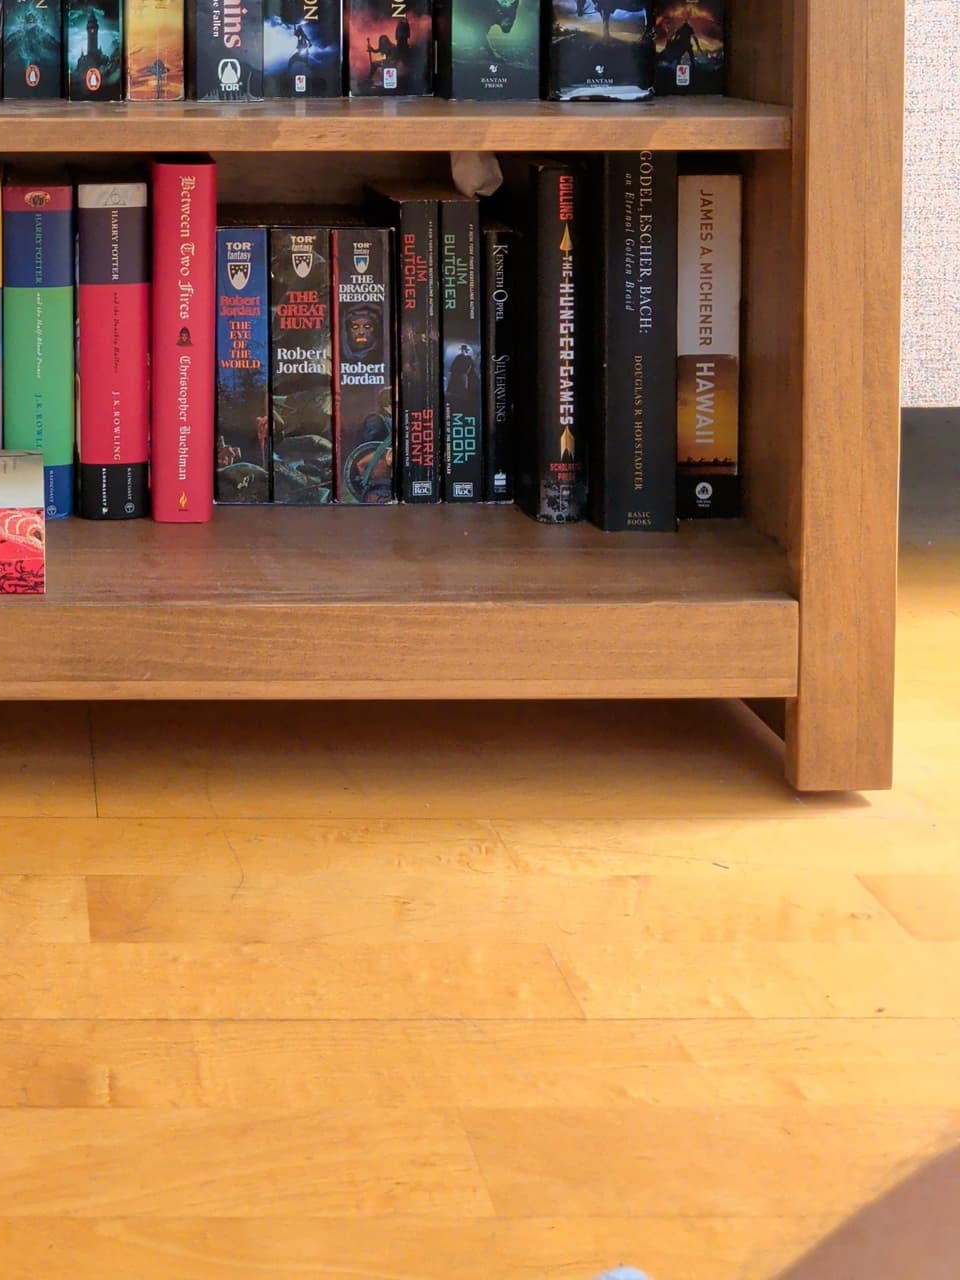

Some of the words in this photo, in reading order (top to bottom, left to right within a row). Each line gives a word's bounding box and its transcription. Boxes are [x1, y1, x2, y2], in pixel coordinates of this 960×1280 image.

[212, 11, 220, 38] Fallen
[111, 210, 119, 244] HARRY
[226, 242, 251, 250] TOR
[111, 247, 119, 281] POTTER
[339, 284, 384, 293] DRAGON
[339, 293, 385, 302] REBORN
[230, 321, 251, 330] THE
[230, 331, 251, 339] EYE
[220, 360, 260, 368] WORLD
[411, 412, 422, 465] FRONT
[422, 409, 433, 466] STORM
[453, 413, 464, 464] MOON
[465, 416, 475, 461] FOOL
